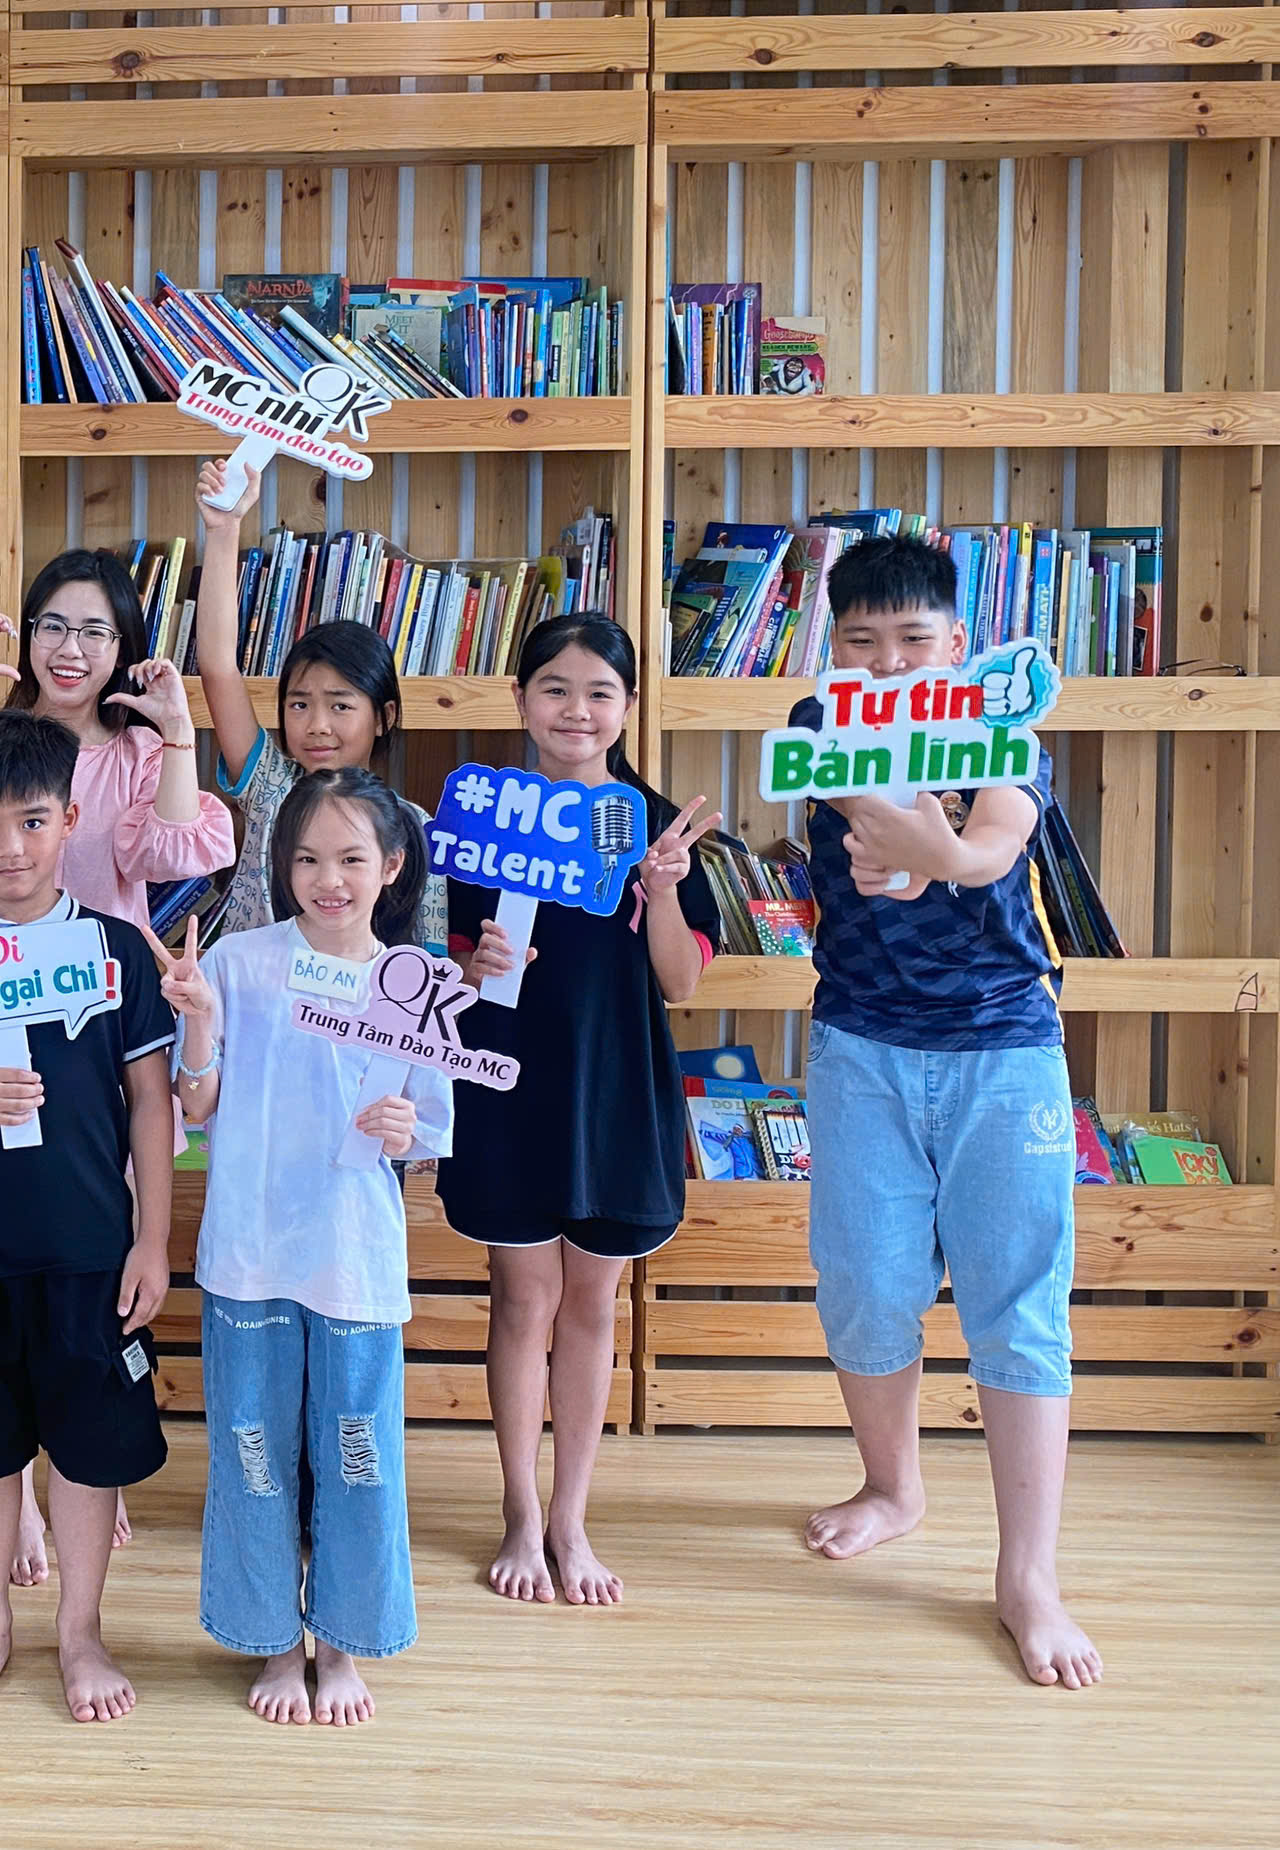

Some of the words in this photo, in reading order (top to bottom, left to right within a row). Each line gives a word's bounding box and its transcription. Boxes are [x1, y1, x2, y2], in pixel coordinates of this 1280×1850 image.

[248, 280, 312, 298] NARNIA
[186, 392, 244, 428] Trung
[188, 364, 261, 406] MC
[255, 396, 328, 434] nhí
[827, 680, 900, 730] Tự
[909, 678, 984, 723] tin
[770, 738, 892, 792] Bản
[906, 726, 1030, 783] lĩnh
[454, 773, 582, 843] #MC
[430, 830, 585, 896] Talent
[294, 955, 328, 981] BẢO
[332, 970, 357, 990] AN
[299, 1004, 352, 1038] Trung
[356, 1020, 394, 1048] Tâm
[399, 1034, 435, 1059] Đào
[440, 1046, 472, 1070] Tạo
[476, 1057, 511, 1081] MC
